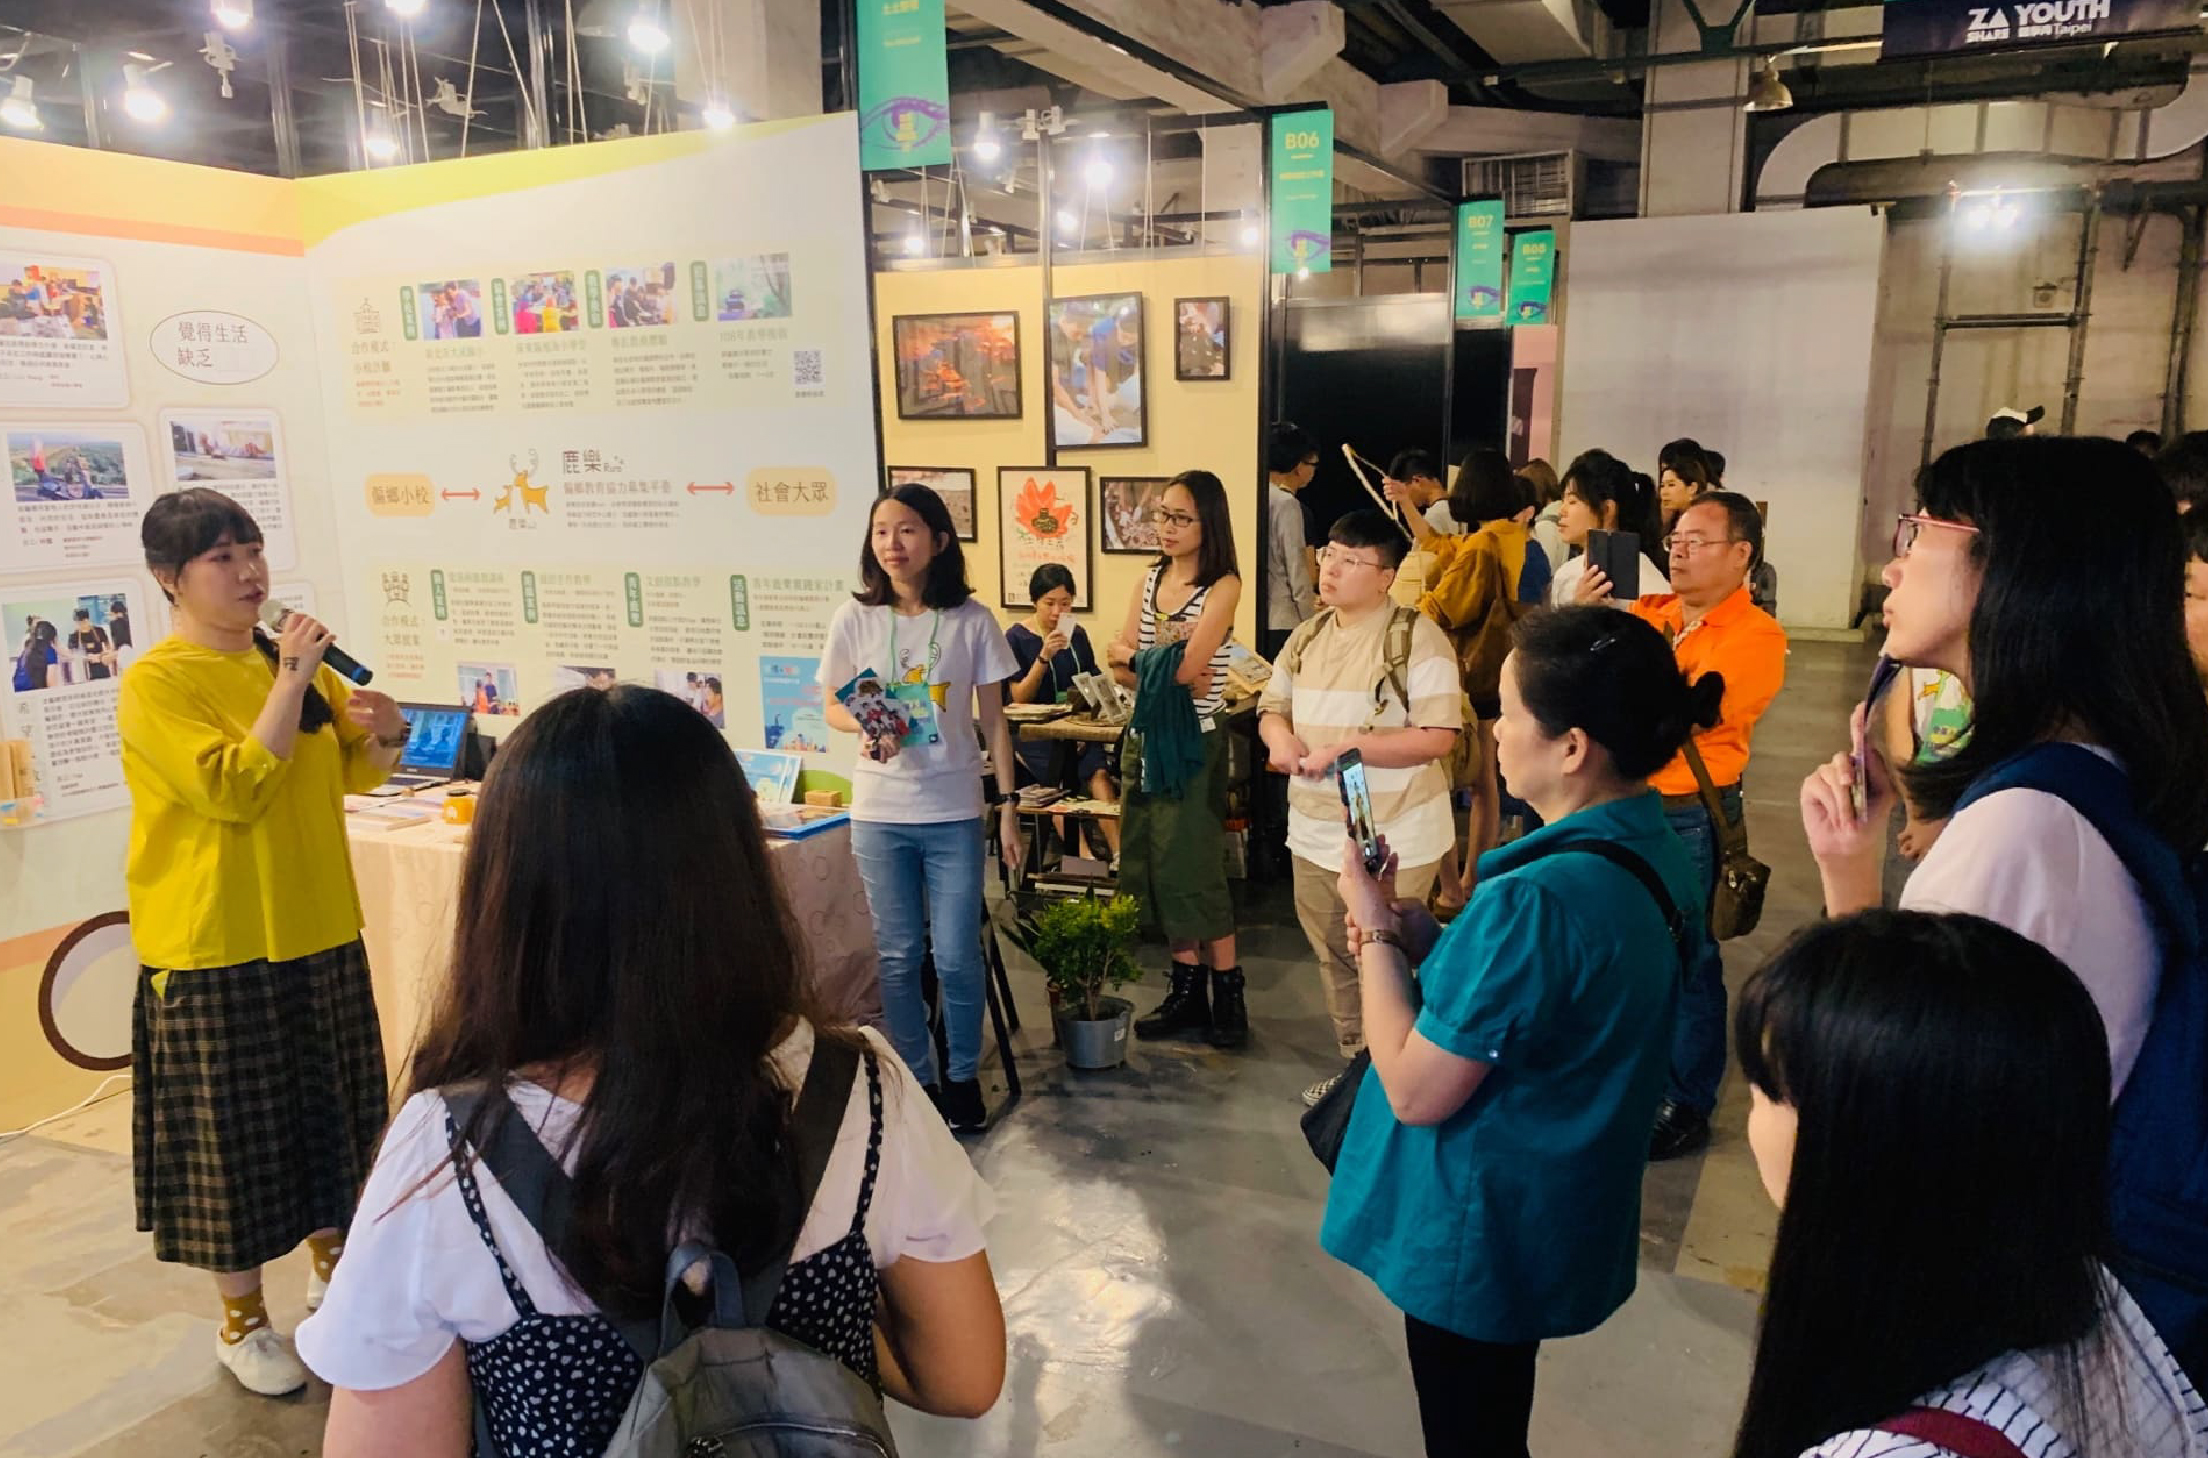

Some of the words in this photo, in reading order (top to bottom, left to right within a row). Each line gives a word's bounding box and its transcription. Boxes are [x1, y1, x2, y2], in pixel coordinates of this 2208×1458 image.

[2014, 0, 2110, 26] YOUTH
[1285, 130, 1320, 150] B06
[1468, 214, 1494, 229] B07
[177, 321, 250, 345] 覺得生活
[177, 347, 214, 368] 缺乏
[755, 481, 829, 503] 社會大眾
